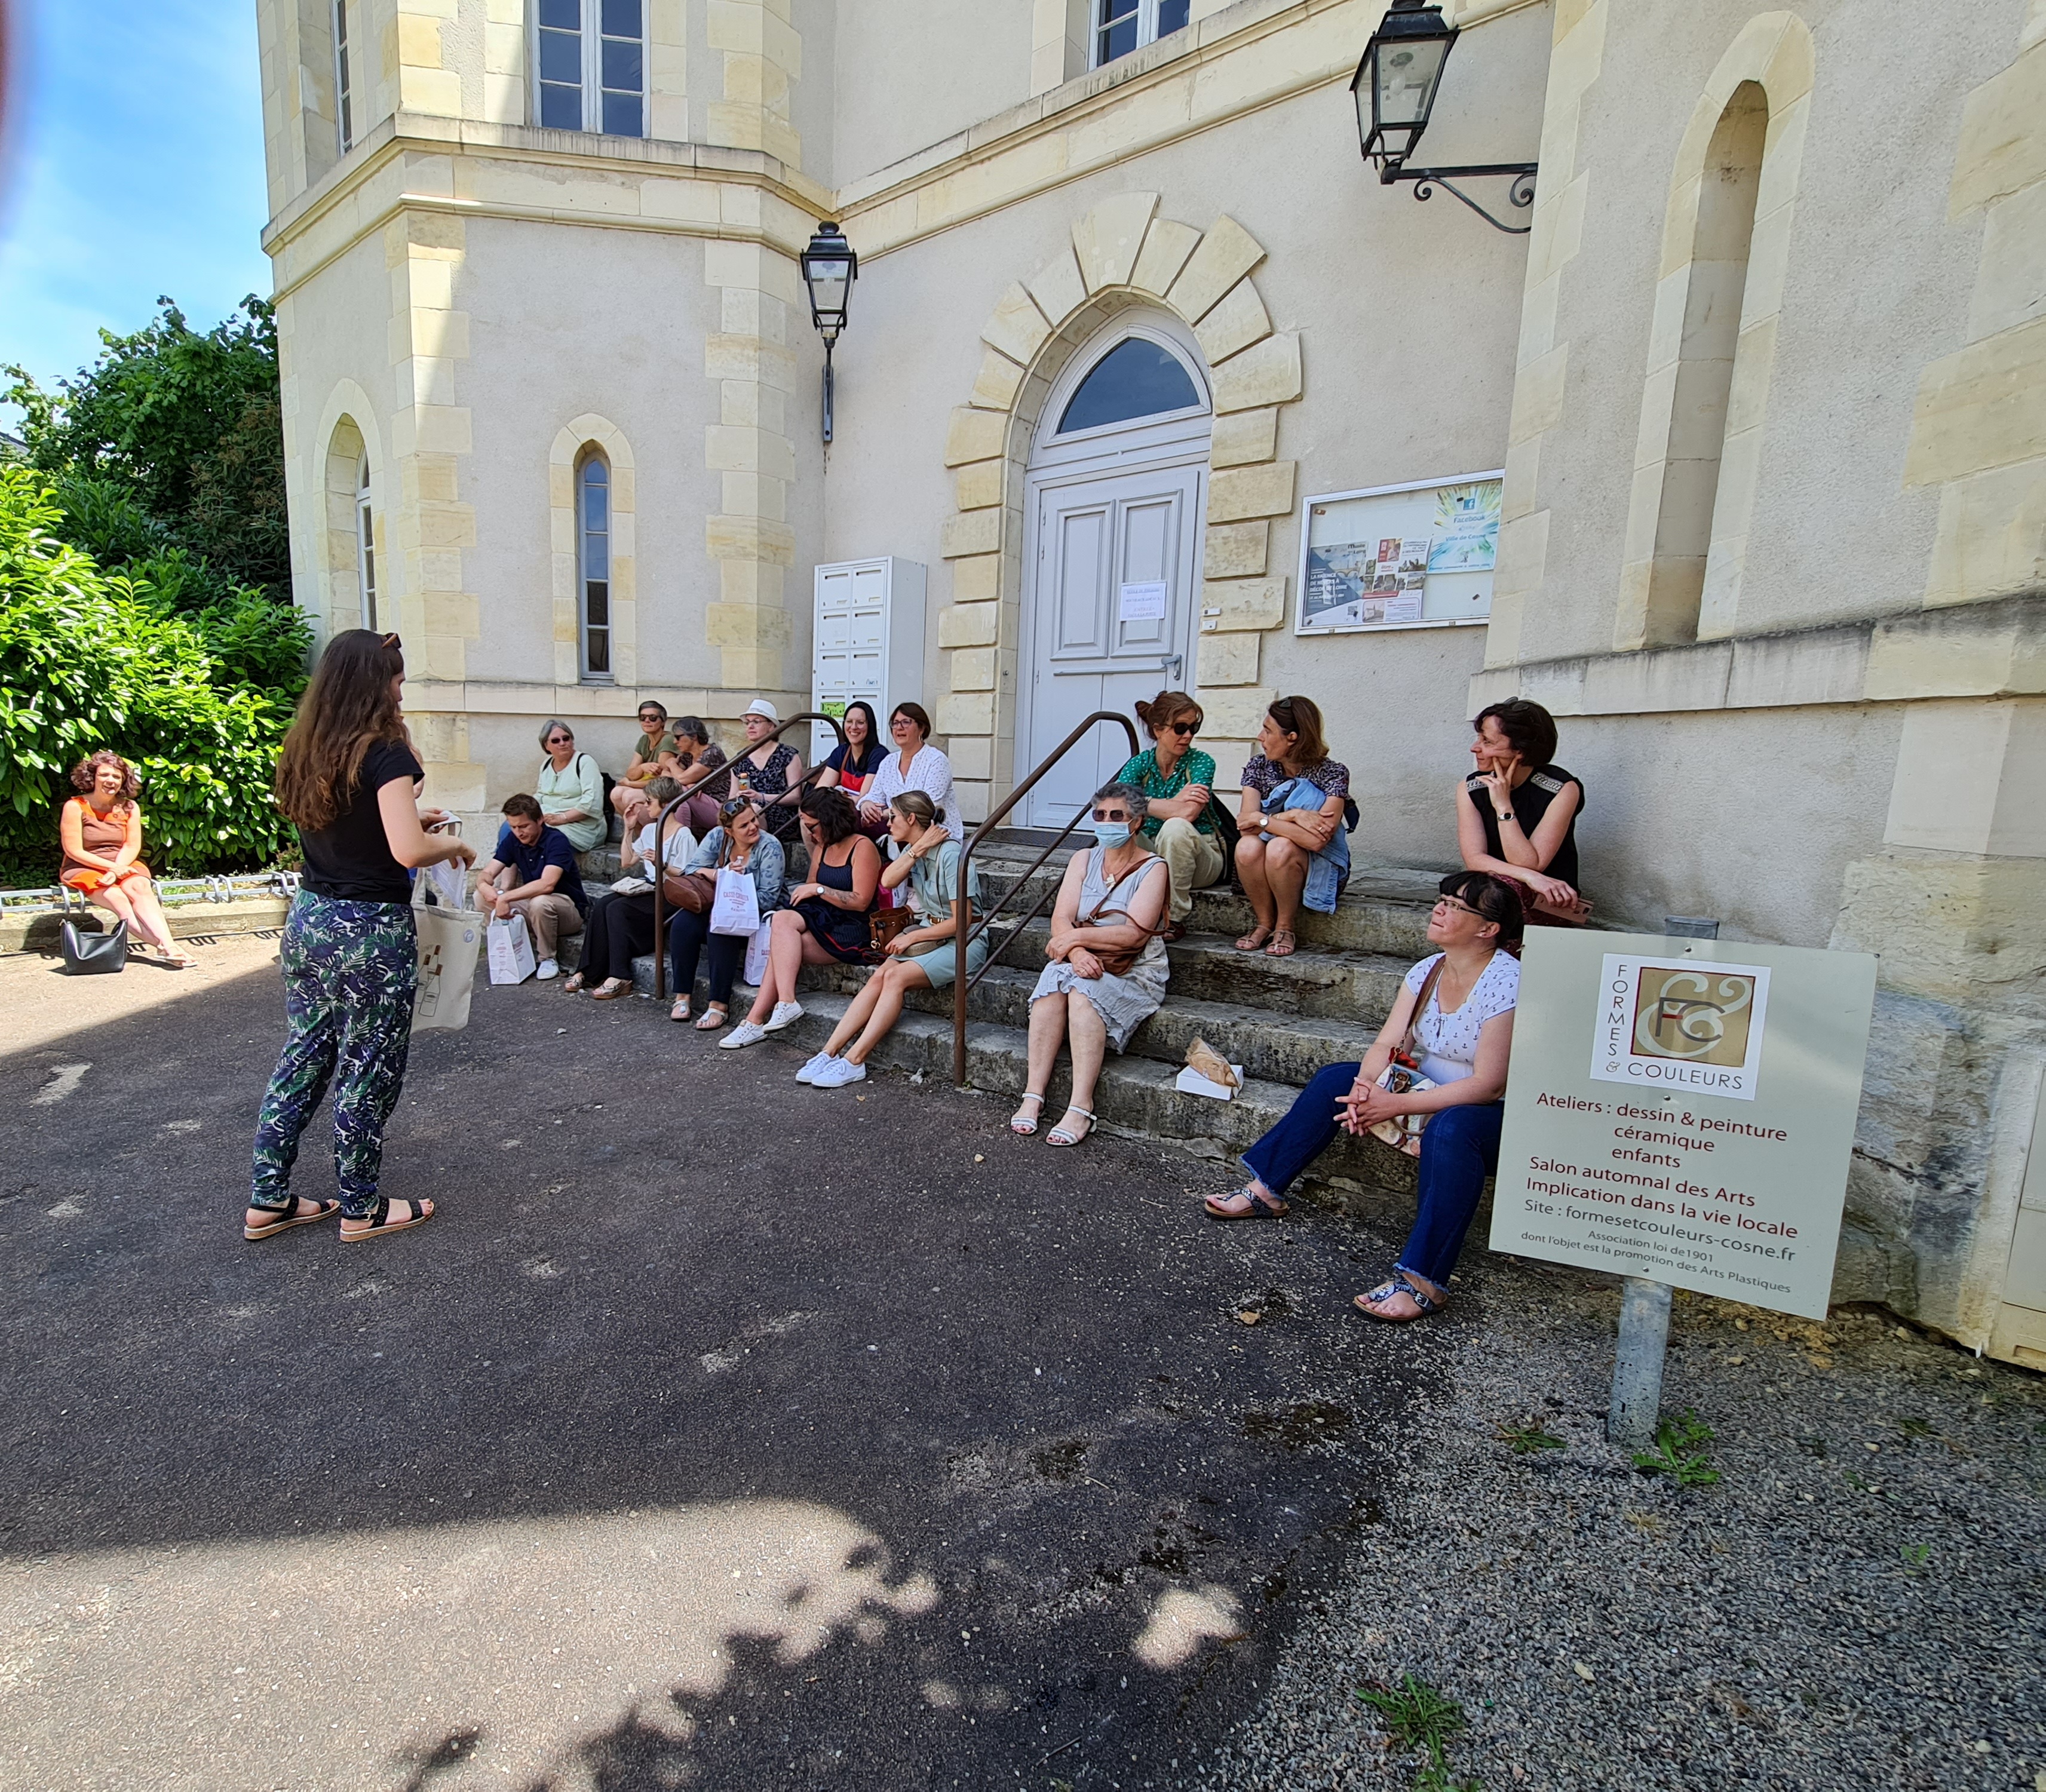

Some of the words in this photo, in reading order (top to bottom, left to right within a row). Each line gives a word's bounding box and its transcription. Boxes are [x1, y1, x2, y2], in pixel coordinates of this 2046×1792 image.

[1453, 515, 1486, 523] Facebook
[1608, 964, 1628, 1056] FORMES
[1606, 1061, 1621, 1073] &
[1628, 1062, 1743, 1090] COULEURS
[1536, 1093, 1602, 1113] Ateliers
[1616, 1103, 1675, 1123] dessin
[1680, 1112, 1695, 1127] &
[1700, 1118, 1788, 1142] peinture
[1614, 1125, 1715, 1152] céramique
[1529, 1156, 1577, 1176] Salon
[1582, 1167, 1670, 1190] automnal
[1675, 1180, 1708, 1198] des
[1714, 1187, 1755, 1207] Arts
[1612, 1147, 1680, 1168] enfants
[1524, 1199, 1554, 1215] Site
[1566, 1205, 1796, 1262] formesetcouleurs-cosne.fr
[1527, 1177, 1625, 1205] Implication
[1631, 1194, 1674, 1214] dans
[1681, 1202, 1697, 1219] la
[1703, 1210, 1731, 1225] vie
[1737, 1213, 1798, 1238] locale
[1521, 1231, 1546, 1243] dont
[1548, 1236, 1581, 1250] l'objet
[1583, 1244, 1599, 1253] est
[1602, 1245, 1611, 1255] la
[1614, 1249, 1674, 1268] promotion
[1676, 1261, 1698, 1272] des
[1700, 1266, 1725, 1279] Arts
[1728, 1271, 1791, 1294] Plastiques
[1588, 1230, 1650, 1249] Association
[1653, 1242, 1667, 1252] loi
